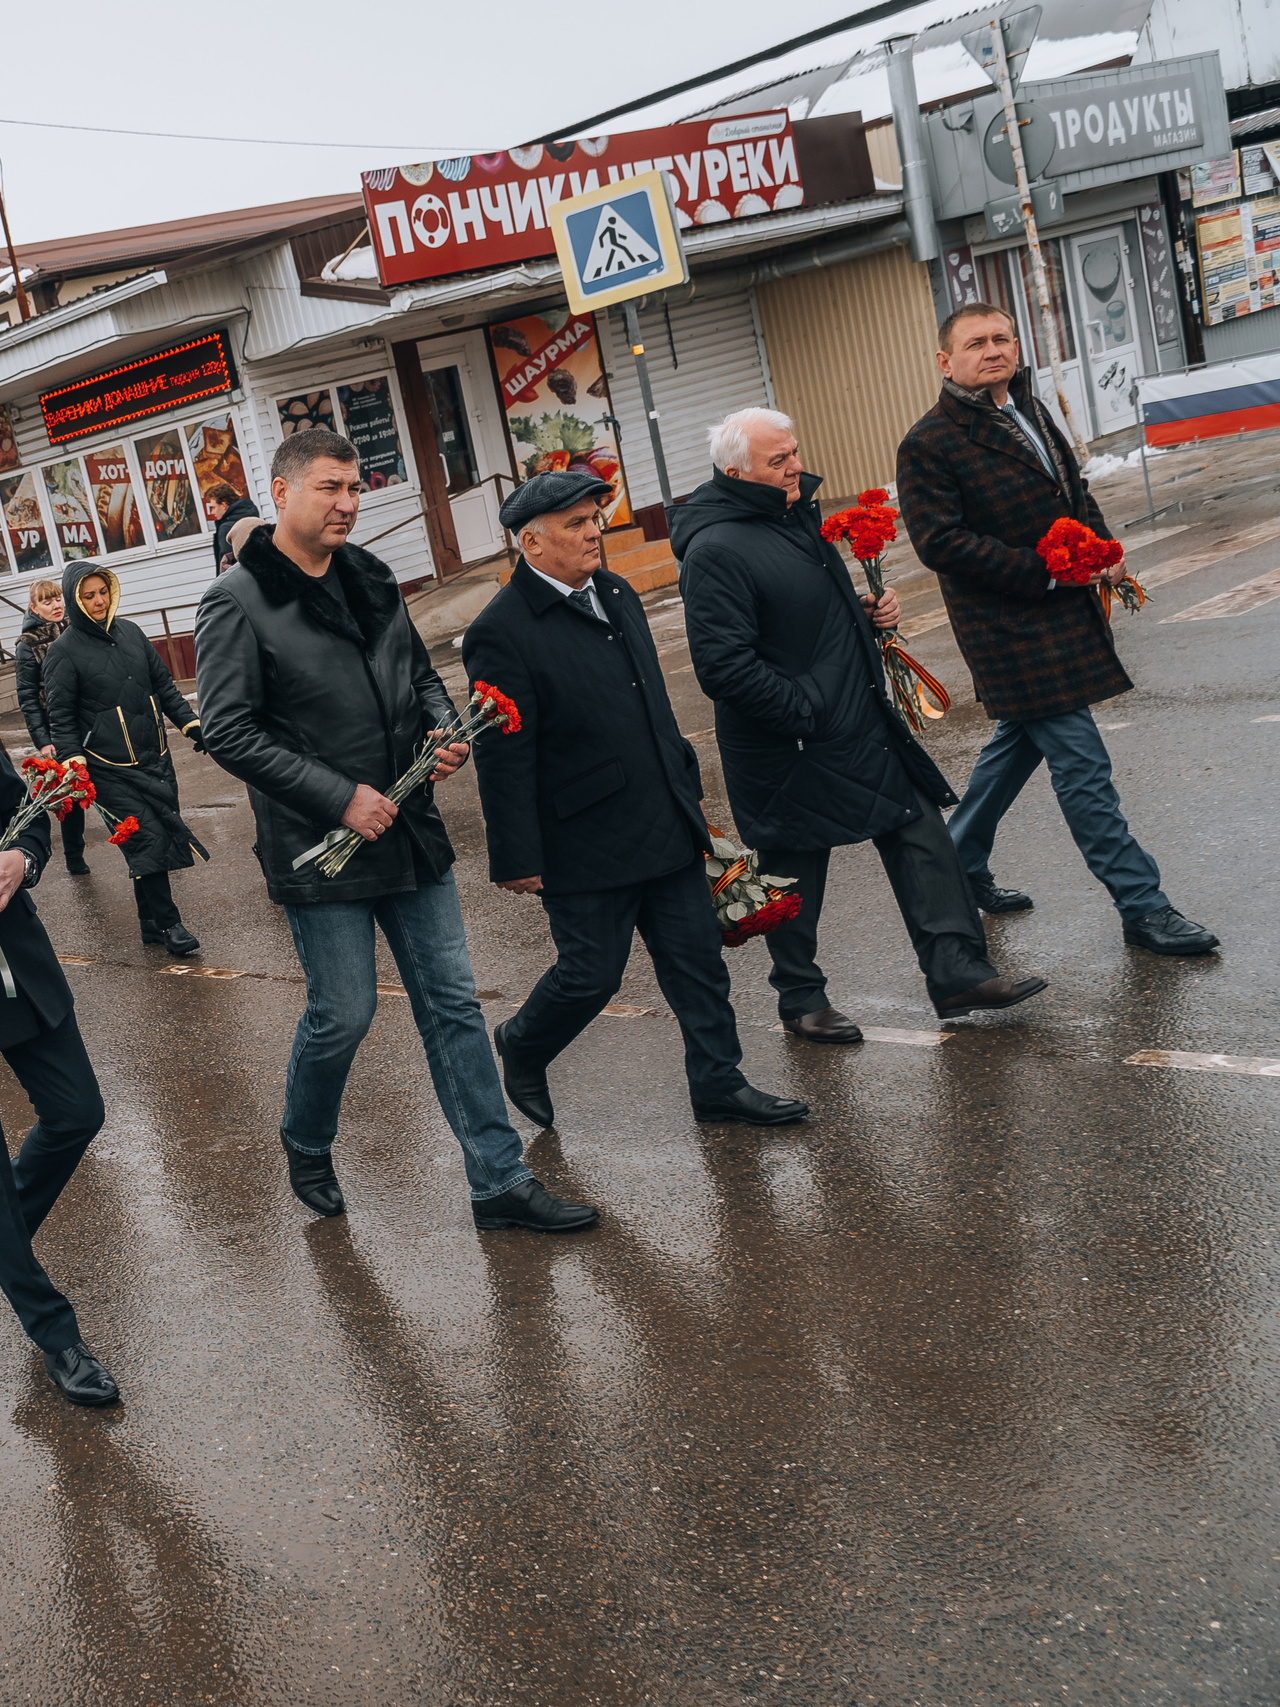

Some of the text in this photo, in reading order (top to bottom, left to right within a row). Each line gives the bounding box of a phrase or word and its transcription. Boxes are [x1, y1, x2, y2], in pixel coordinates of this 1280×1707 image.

[1153, 127, 1198, 148] МАГАЗИН
[607, 136, 800, 204] БУРЕКИ
[505, 321, 590, 397] ШАУРМА
[145, 458, 187, 479] ДОГИ
[16, 530, 41, 549] УР
[62, 524, 93, 544] МА
